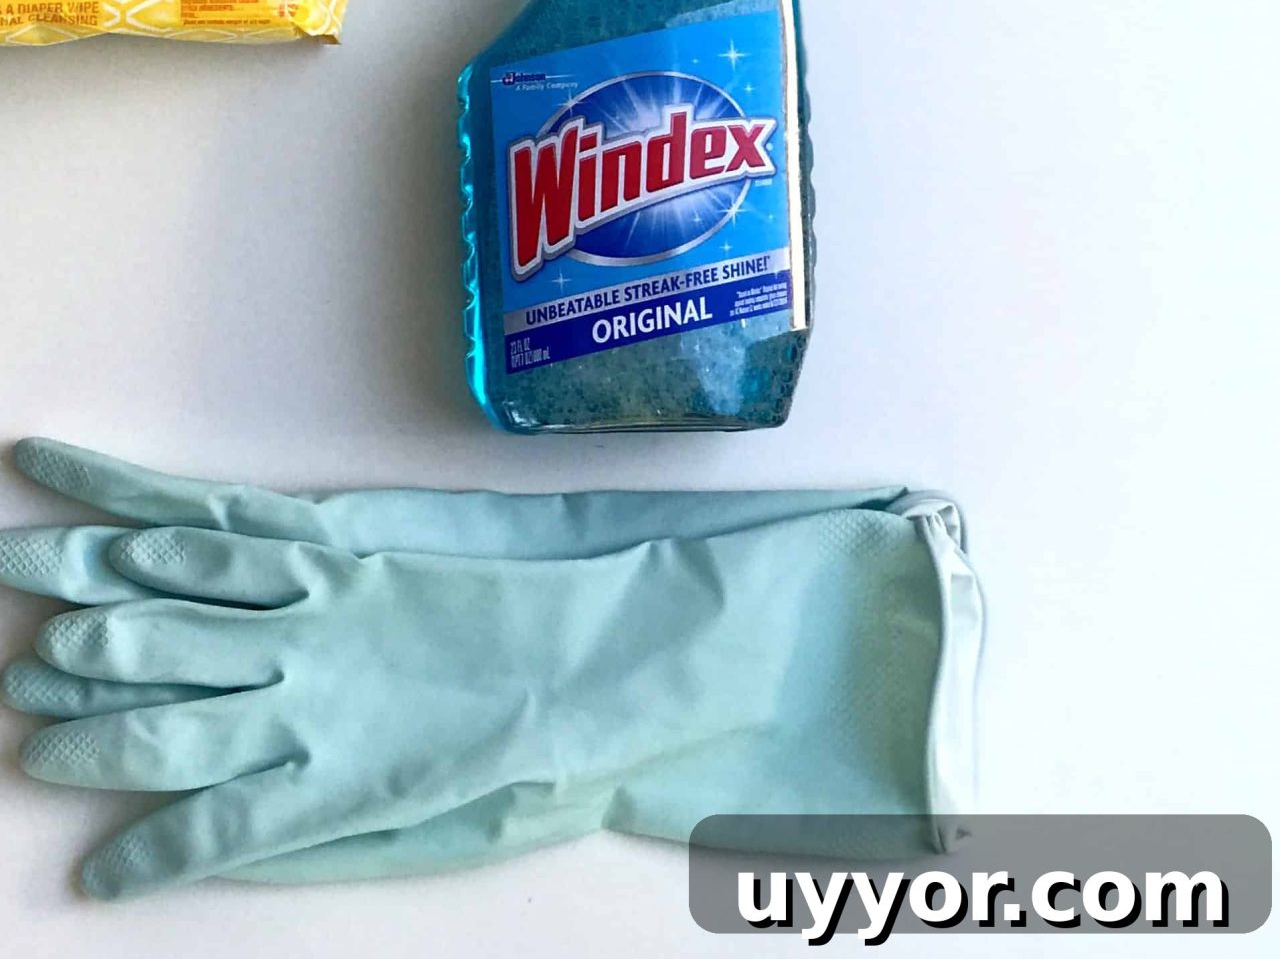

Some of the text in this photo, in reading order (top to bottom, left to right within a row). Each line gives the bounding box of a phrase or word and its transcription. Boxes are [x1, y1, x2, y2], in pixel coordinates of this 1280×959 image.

[6, 4, 14, 15] A
[18, 3, 63, 14] DIAPER
[67, 1, 99, 14] WIPE
[28, 13, 98, 26] CLEANSING
[511, 109, 770, 270] Windex
[525, 290, 620, 325] UNBEATABLE
[624, 267, 719, 302] STREAK-FREE
[591, 296, 713, 344] ORIGINAL
